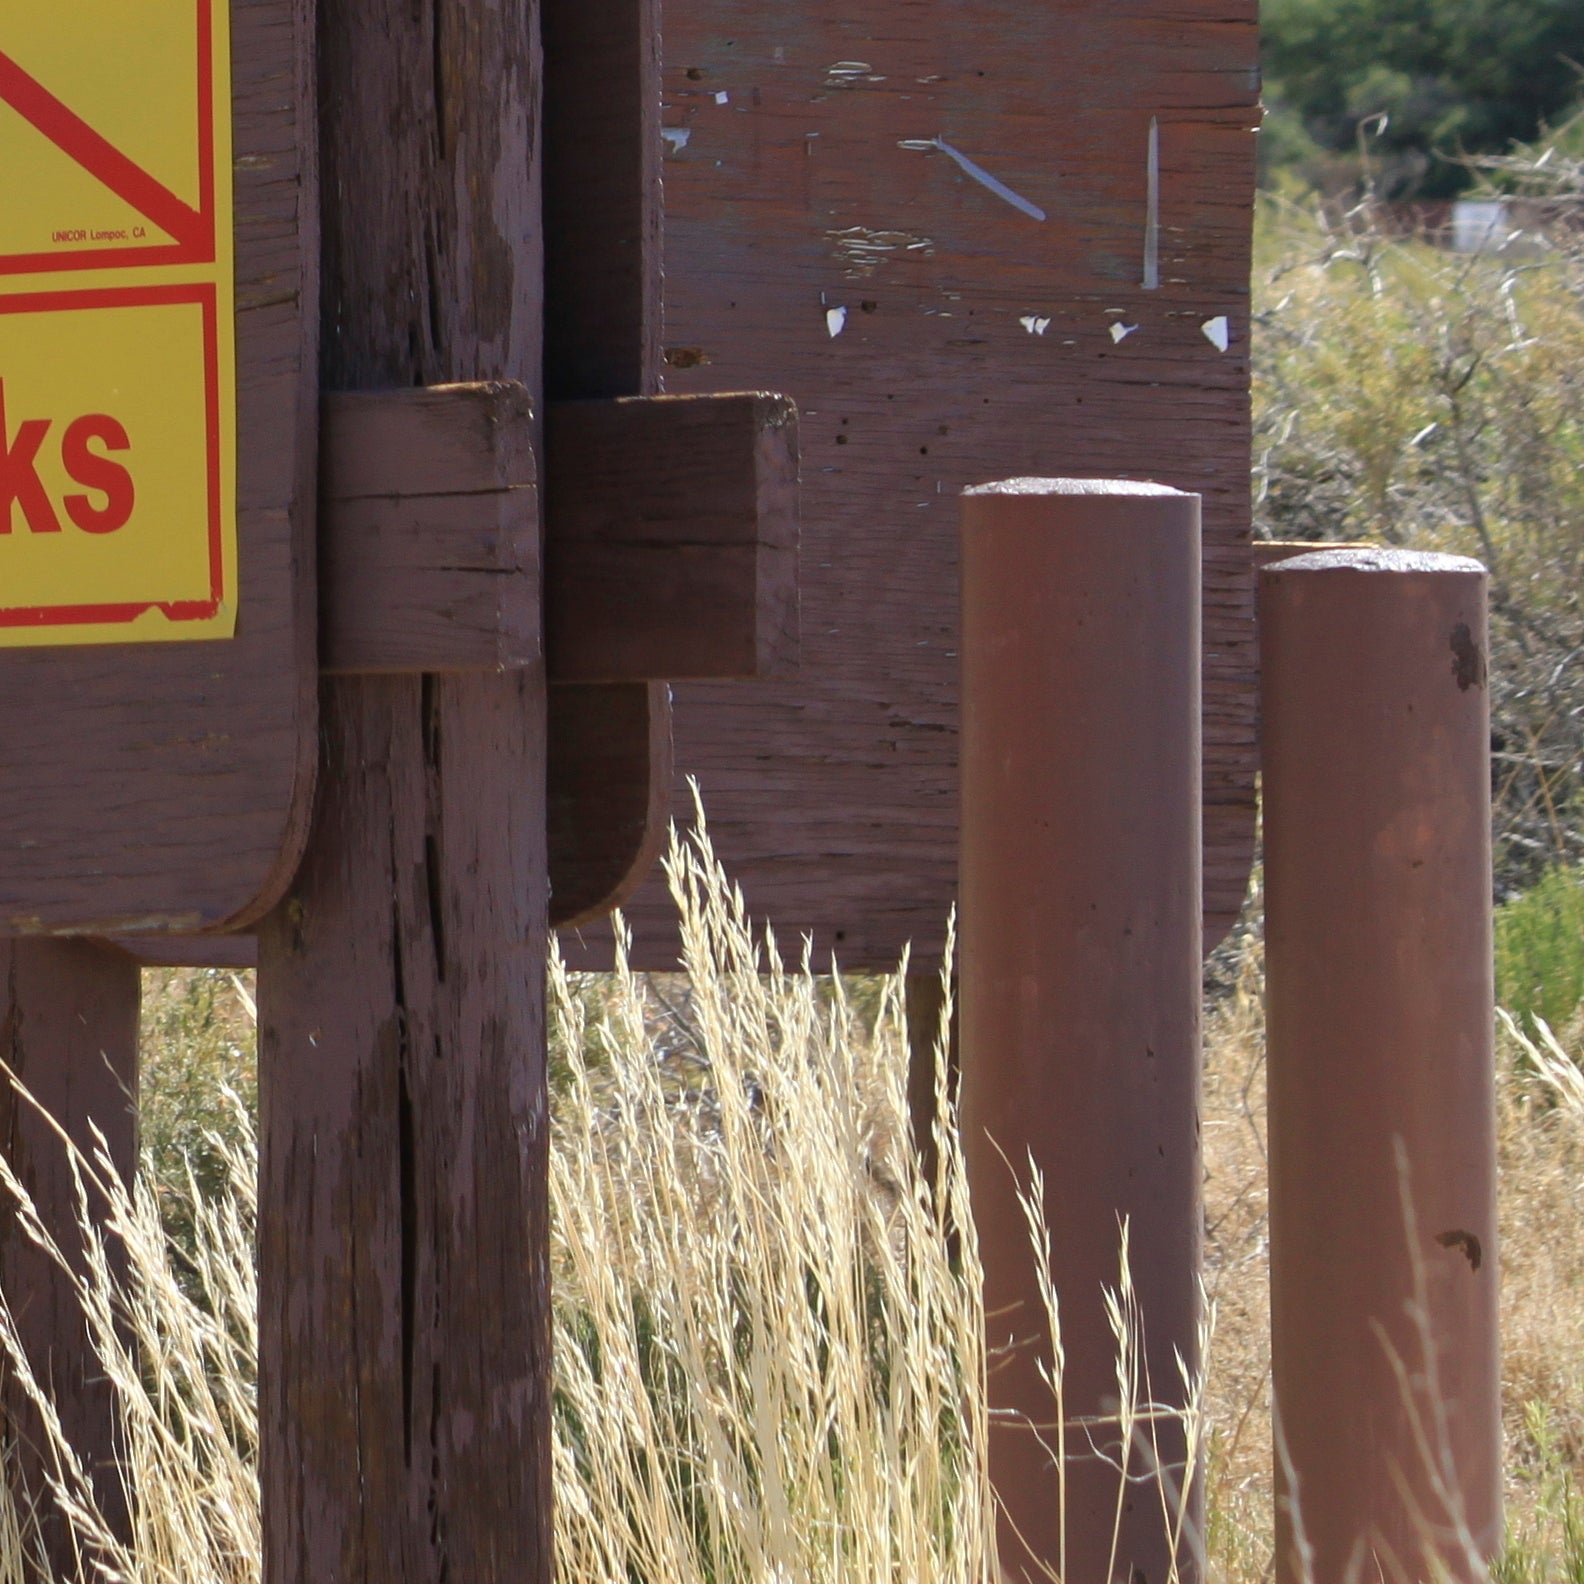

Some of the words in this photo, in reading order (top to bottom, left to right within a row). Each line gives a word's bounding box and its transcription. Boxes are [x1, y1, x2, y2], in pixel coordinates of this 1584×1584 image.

[52, 229, 87, 243] UNICOR
[90, 229, 129, 242] Lompoc,
[132, 226, 147, 238] CA
